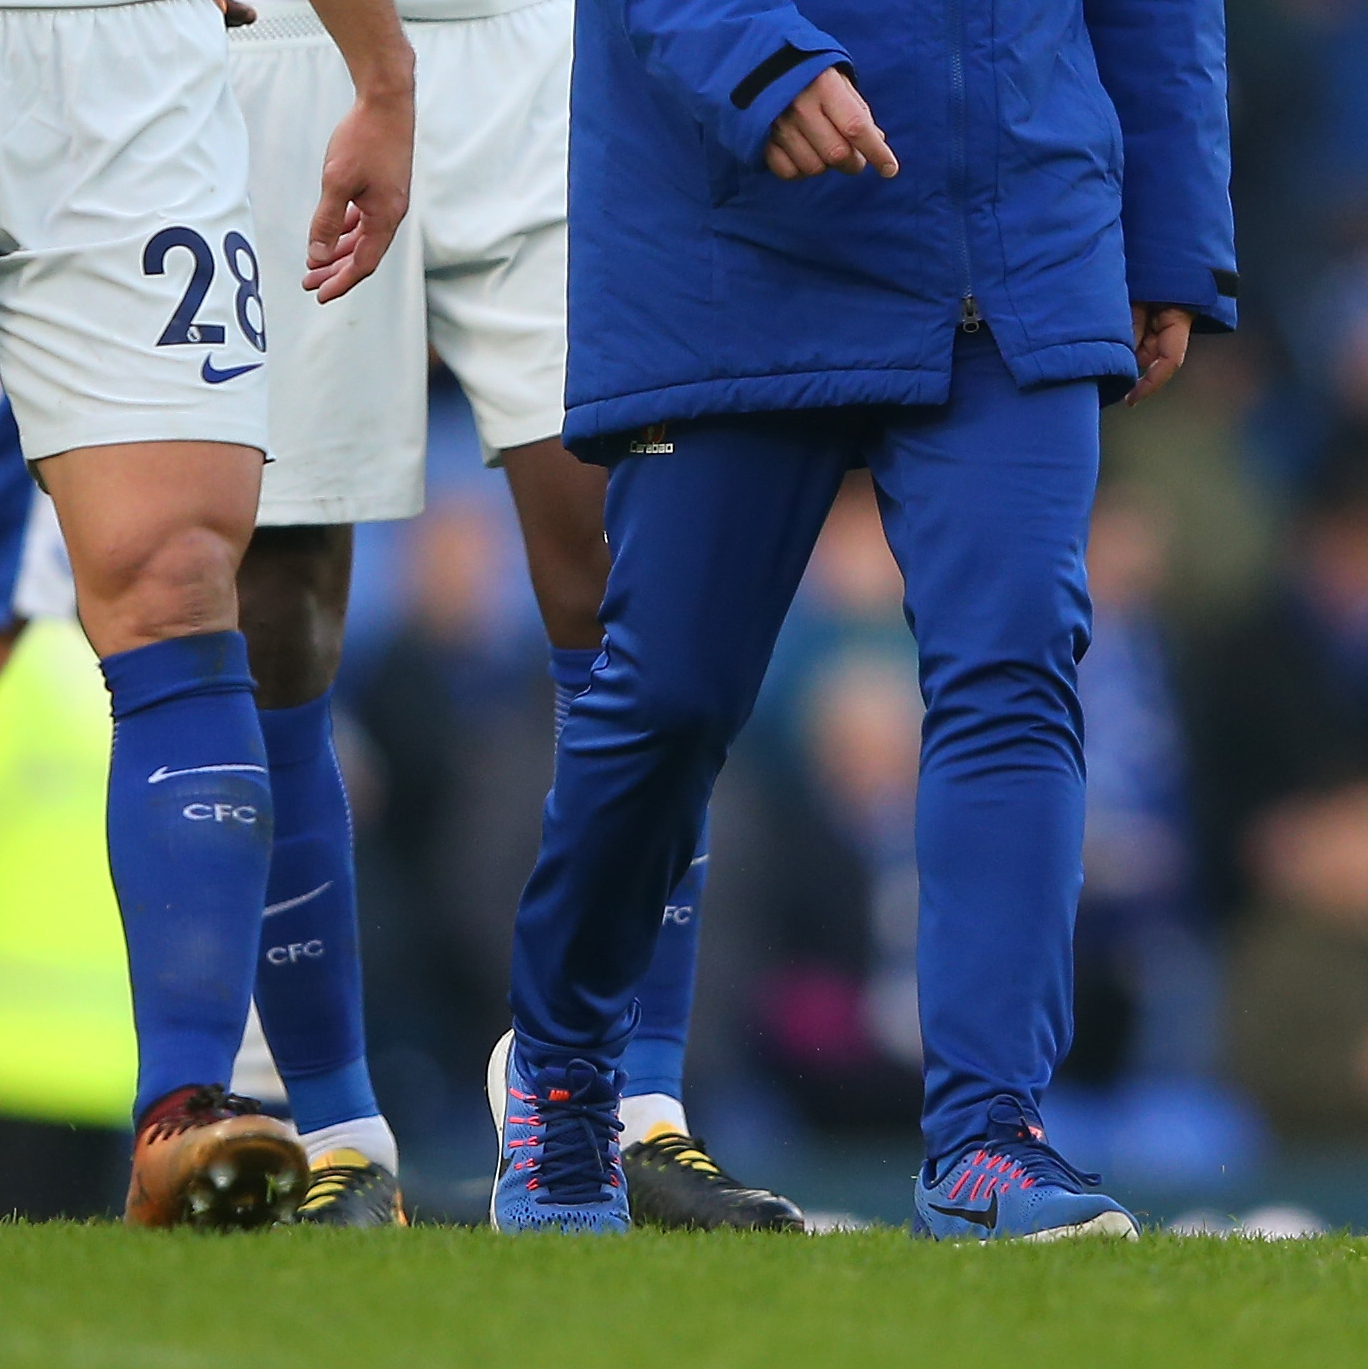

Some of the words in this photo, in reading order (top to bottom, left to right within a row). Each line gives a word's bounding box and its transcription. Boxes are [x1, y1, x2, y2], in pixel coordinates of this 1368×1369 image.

[143, 226, 267, 353] 28
[182, 802, 258, 825] CFC
[265, 938, 325, 966] CFC
